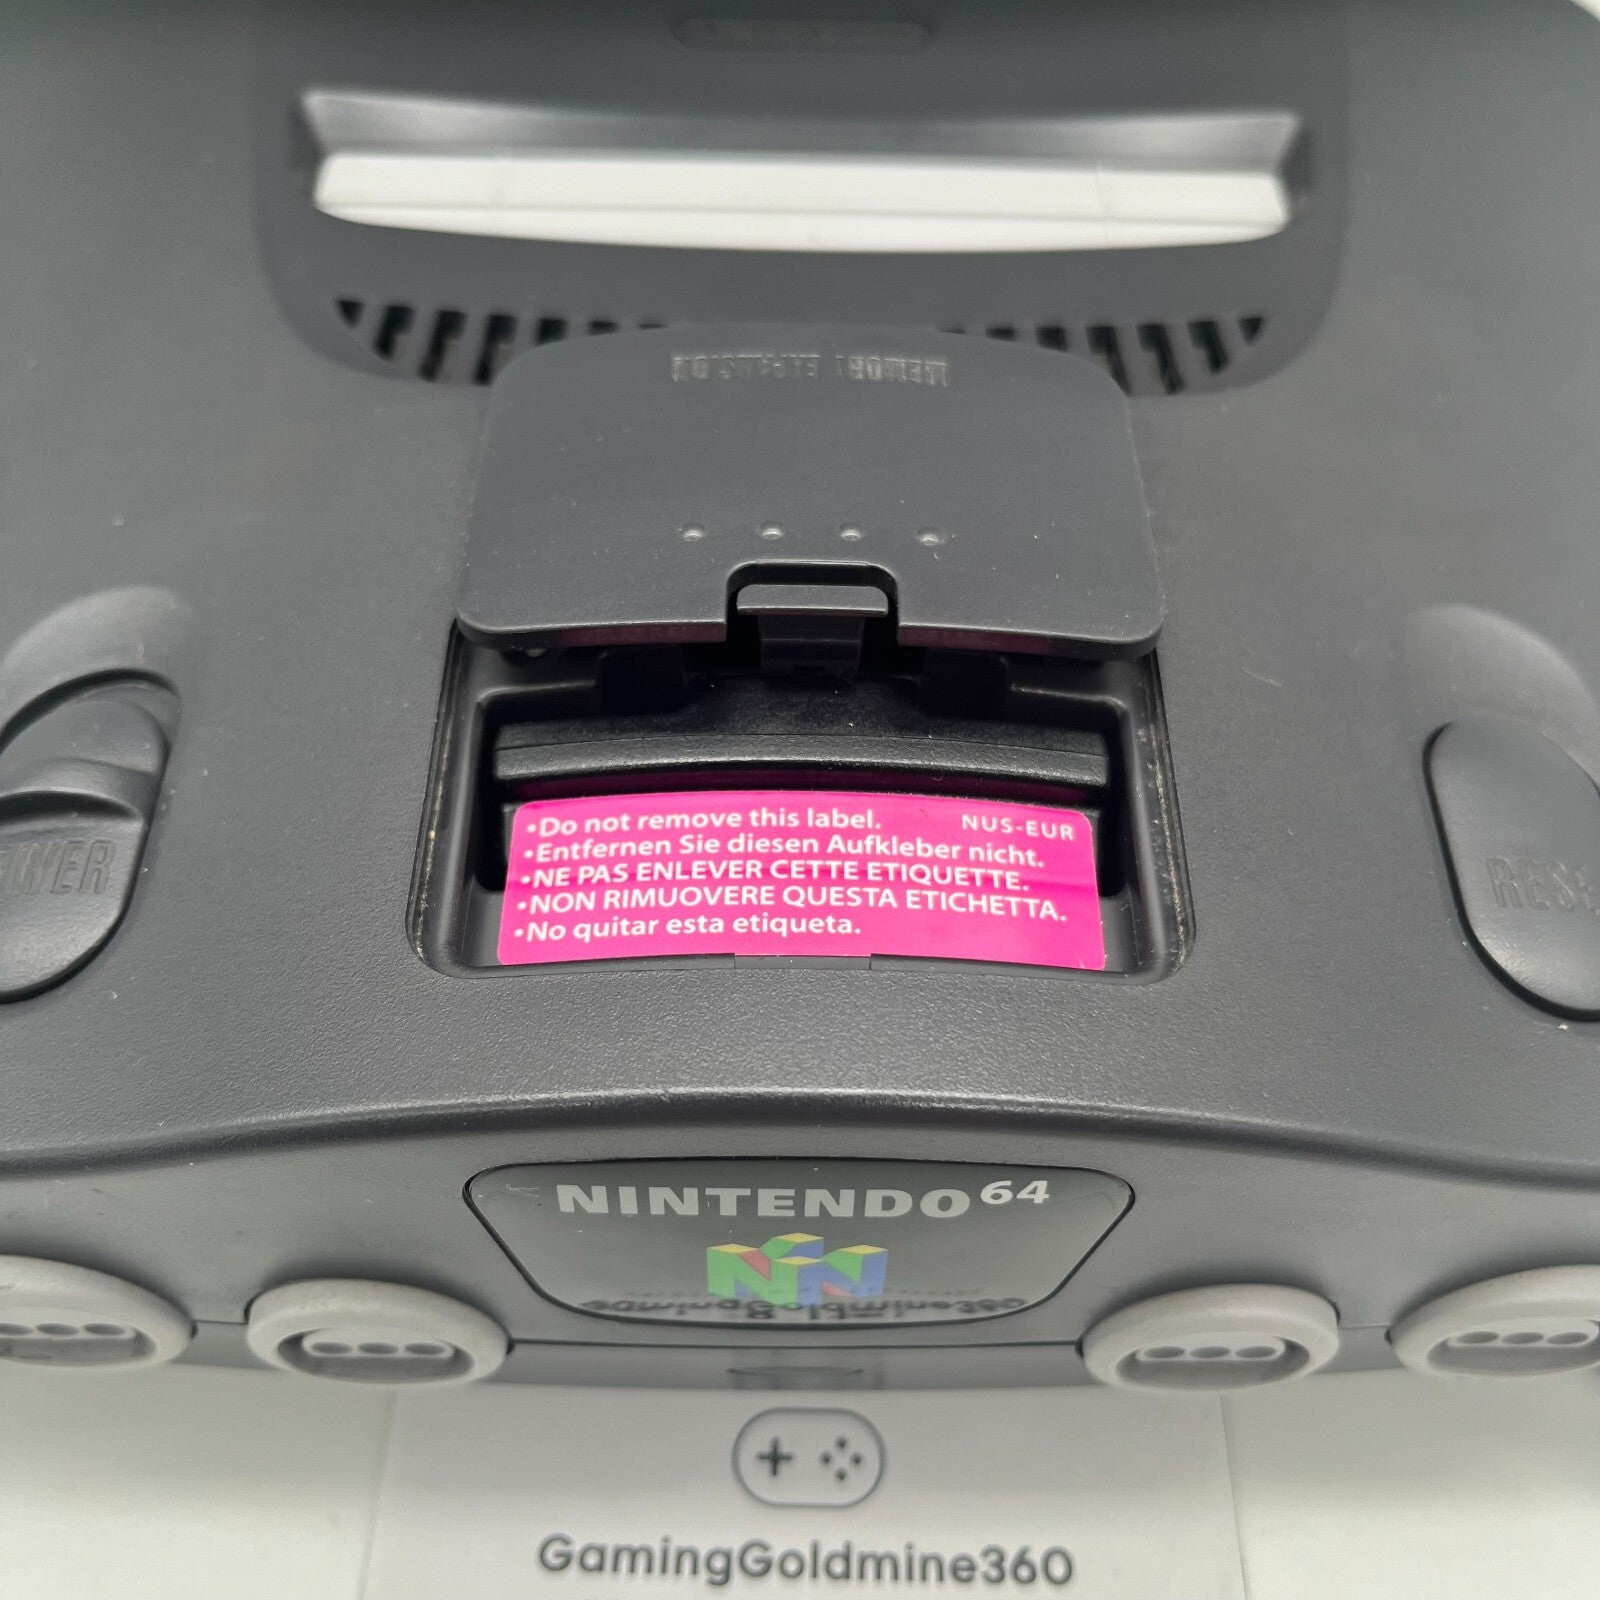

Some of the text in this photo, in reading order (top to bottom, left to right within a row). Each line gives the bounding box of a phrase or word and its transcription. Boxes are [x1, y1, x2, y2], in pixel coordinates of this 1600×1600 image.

[539, 807, 881, 837] Do not remove this label.
[961, 813, 1076, 842] NUS-EUR
[0, 837, 117, 898] WER
[536, 833, 1044, 868] Entfernen Sie diesen Aufkleber nicht.
[533, 859, 1028, 891] NE PAS ENLEVER CETTE ETIQUETTE.
[530, 885, 1067, 922] NON RIMUOVERE QUESTA ETICHETTA.
[526, 913, 861, 943] No quitar esta etiqueta.
[555, 1180, 1051, 1219] NINTENDO 64
[537, 1532, 1074, 1587] GamingGoldmine360
